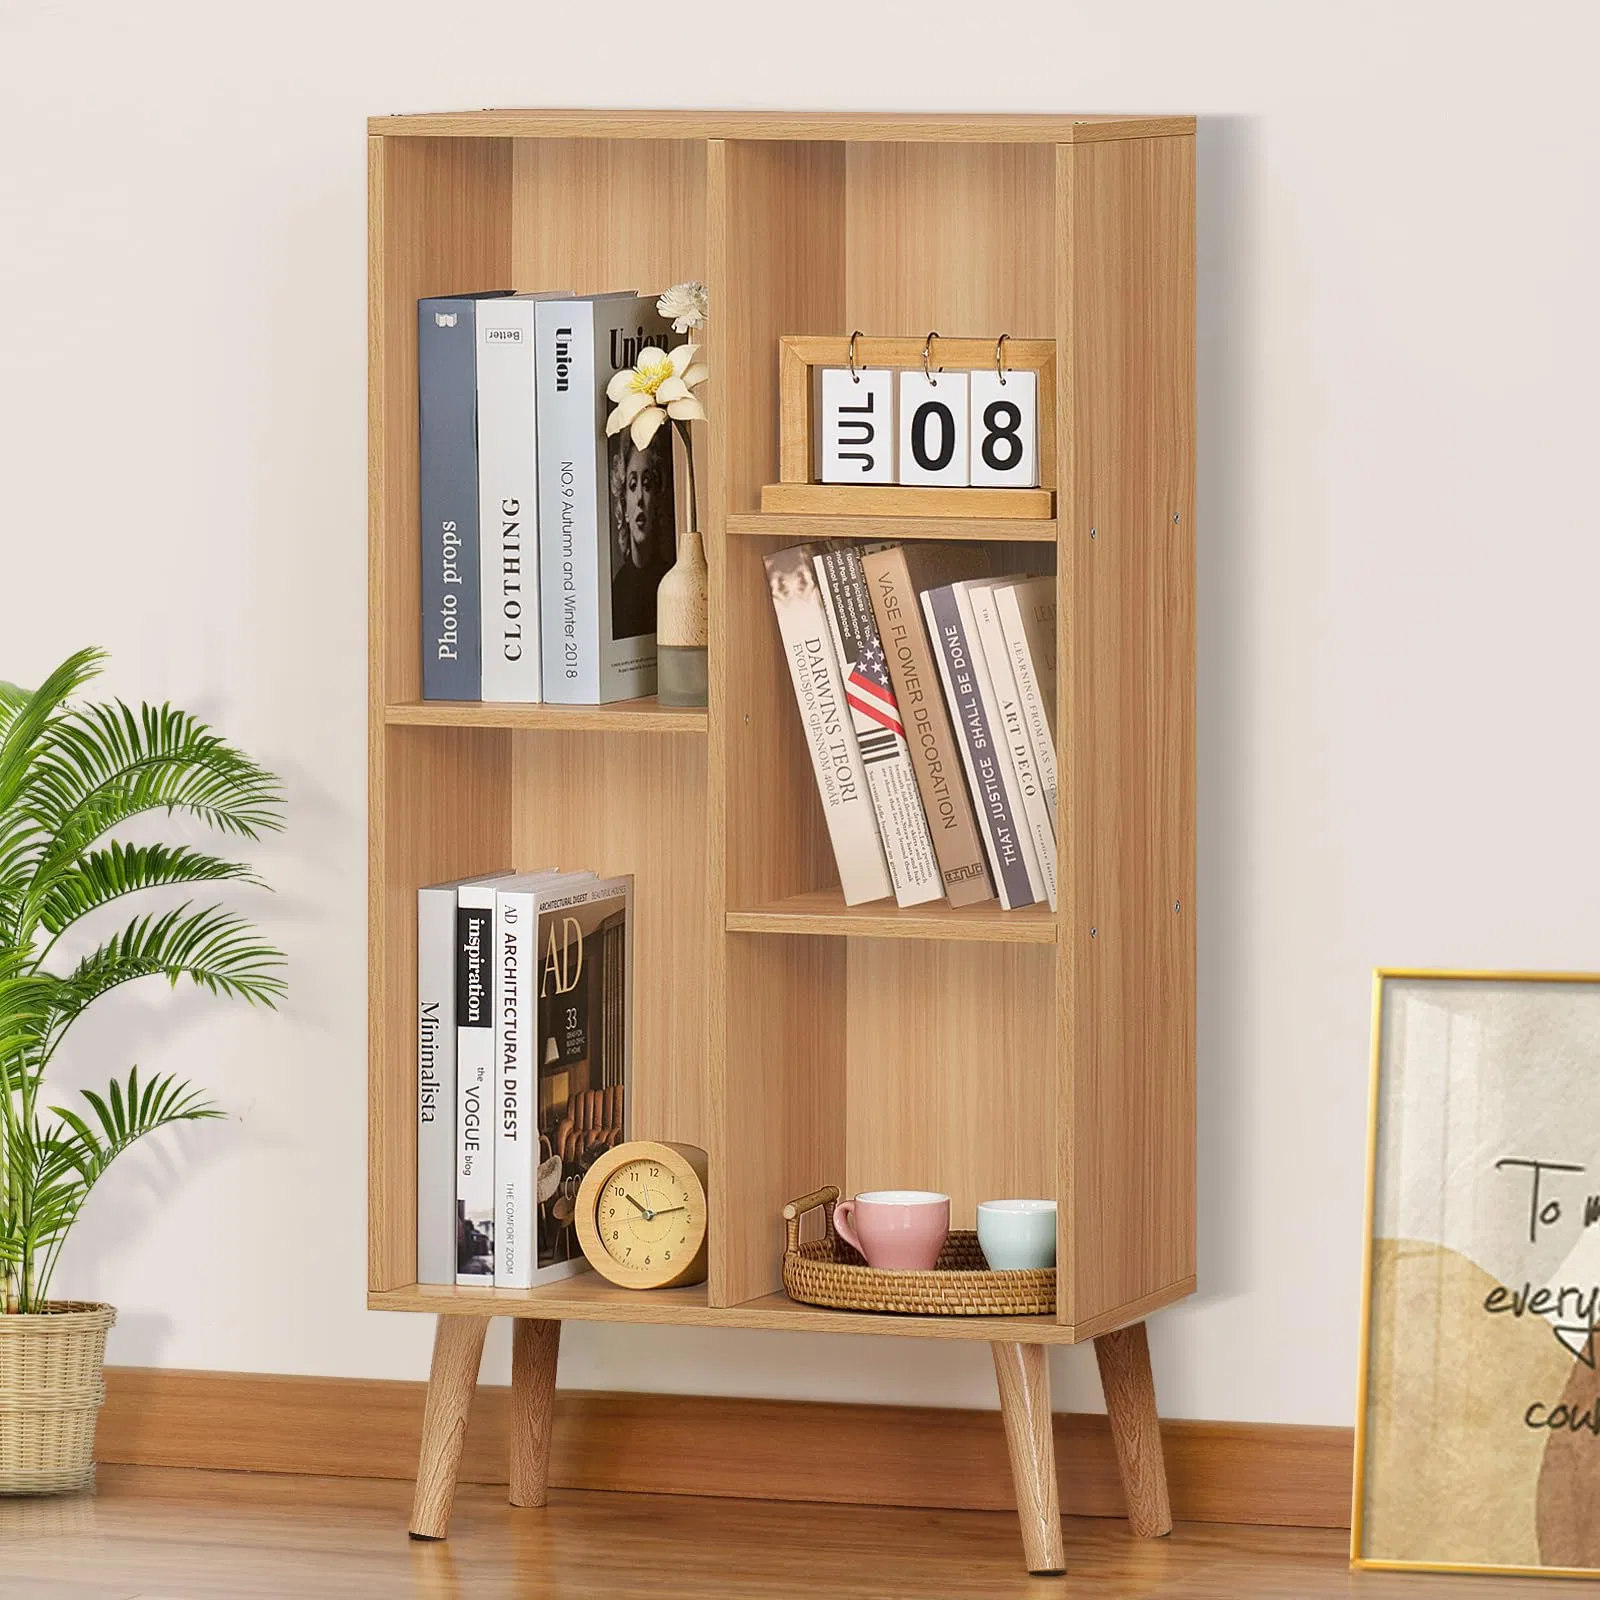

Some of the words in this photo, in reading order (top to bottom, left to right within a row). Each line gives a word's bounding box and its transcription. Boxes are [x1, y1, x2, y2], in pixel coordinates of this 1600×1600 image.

[489, 331, 520, 340] Better
[556, 328, 572, 392] Union
[838, 392, 875, 472] JUL
[561, 461, 574, 498] NO.9
[561, 501, 574, 557] Autumn
[443, 520, 462, 584] props
[502, 498, 522, 661] CLOTHING
[562, 562, 575, 591] and
[825, 555, 837, 581] cannot
[832, 582, 840, 592] be
[843, 584, 851, 597] the
[845, 552, 857, 579] famous
[852, 582, 865, 611] pictures
[438, 594, 458, 660] Photo
[563, 595, 577, 639] Winter
[845, 597, 861, 639] importance
[565, 643, 578, 679] 2018
[945, 624, 966, 669] DONE
[879, 571, 902, 621] VASE
[891, 624, 924, 704] FLOWER
[913, 708, 957, 829] DECORATION
[957, 672, 973, 695] BE
[1013, 640, 1035, 701] LEARNING
[1029, 705, 1044, 737] FROM
[1038, 741, 1050, 764] LAS
[793, 643, 816, 710] EVOLUSJON
[809, 713, 831, 771] GJENNOM
[805, 637, 841, 735] DARWINS
[830, 739, 858, 802] TEORI
[965, 698, 987, 749] SHALL
[1002, 699, 1021, 735] ART
[1014, 745, 1036, 796] DECO
[980, 757, 1006, 821] JUSTICE
[997, 827, 1017, 866] THAT
[505, 904, 518, 924] AD
[463, 917, 485, 1022] inspiration
[540, 917, 583, 998] AD
[504, 932, 517, 1074] ARCHITECTURAL
[566, 1007, 577, 1030] 33
[421, 1001, 440, 1122] Minimalista
[477, 1067, 485, 1082] the
[465, 1086, 480, 1151] VOGUE
[504, 1080, 517, 1141] DIGEST
[463, 1156, 473, 1176] blog
[630, 1173, 639, 1181] 11
[649, 1168, 659, 1177] 12
[671, 1176, 675, 1184] 1
[506, 1183, 514, 1200] THE
[609, 1208, 615, 1217] 9
[614, 1187, 624, 1196] 10
[683, 1193, 689, 1201] 2
[1495, 1159, 1586, 1243] To
[506, 1201, 514, 1245] COMFORT
[613, 1231, 619, 1240] 8
[506, 1247, 514, 1275] ZOOM
[626, 1248, 632, 1257] 7
[645, 1256, 651, 1264] 6
[664, 1251, 671, 1260] 5
